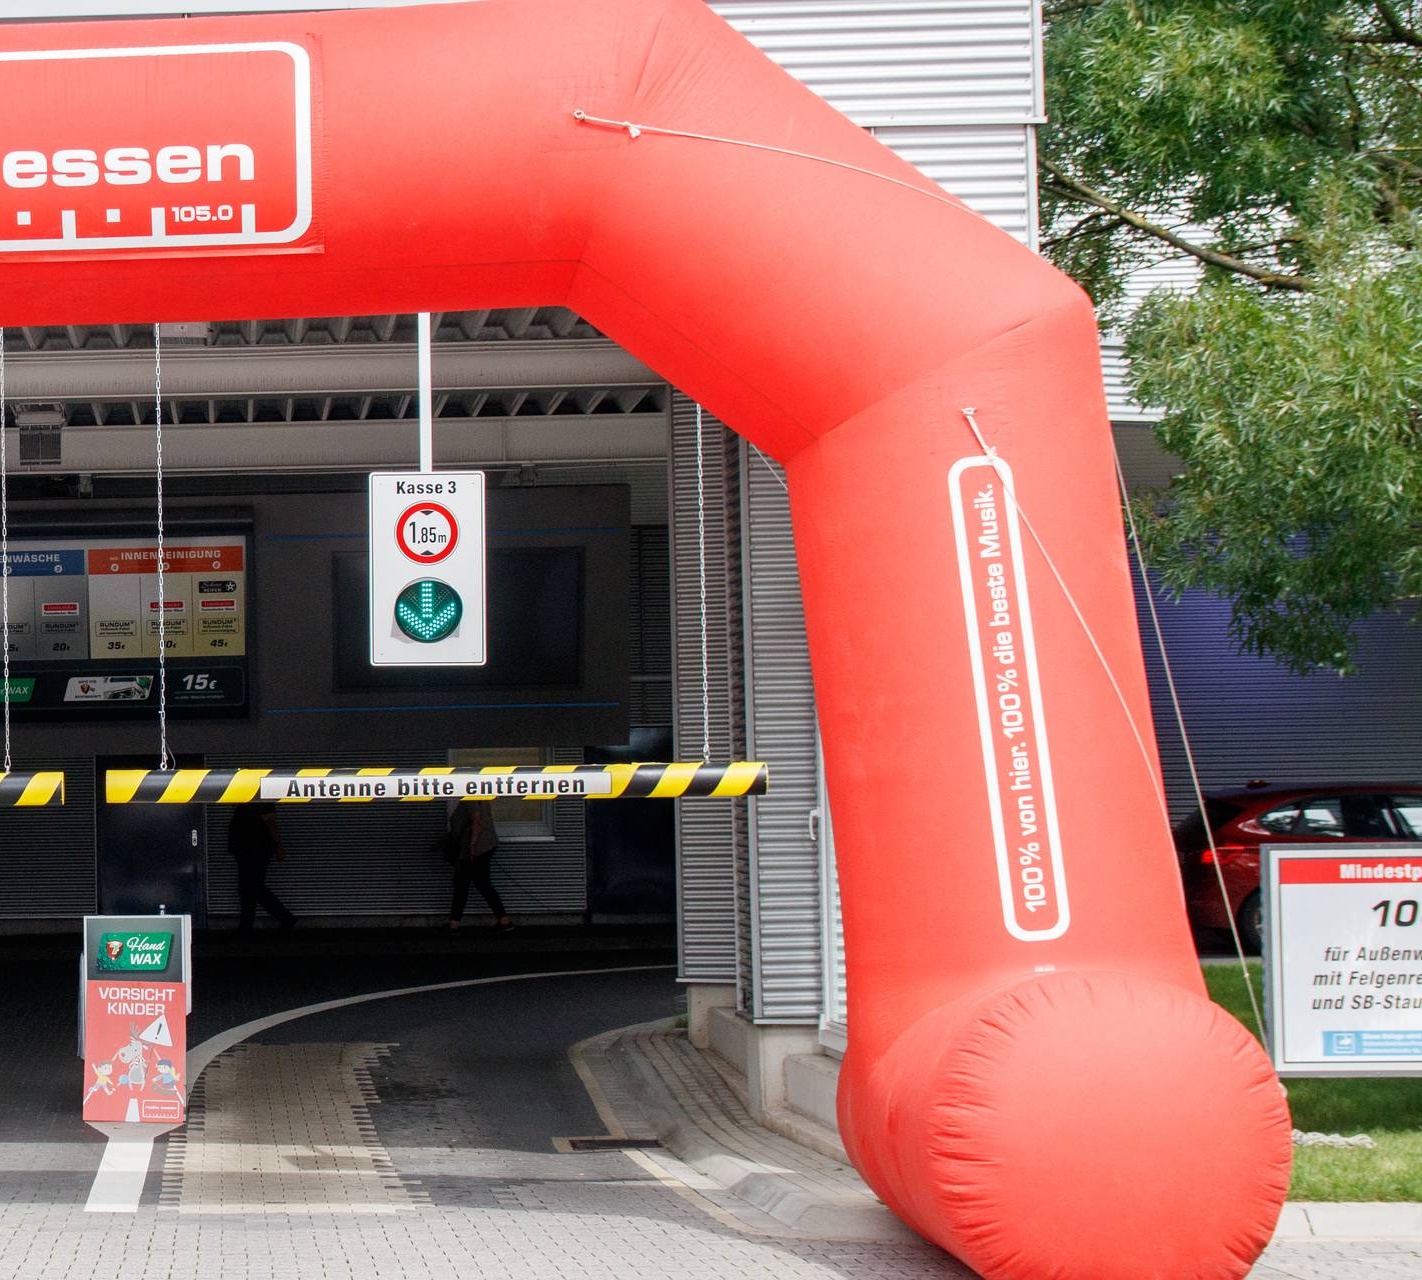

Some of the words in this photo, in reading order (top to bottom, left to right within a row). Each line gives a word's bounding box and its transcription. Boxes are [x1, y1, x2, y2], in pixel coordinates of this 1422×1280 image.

[3, 143, 255, 187] essen
[171, 205, 233, 223] 105.0
[396, 481, 443, 494] Kasse
[448, 481, 457, 494] 3
[974, 483, 1001, 559] Musik.
[987, 563, 1010, 627] beste
[993, 632, 1015, 664] die
[182, 673, 217, 690] 15€
[1009, 742, 1032, 790] hier.
[287, 779, 386, 797] Antenne
[397, 778, 454, 796] bitte
[465, 778, 585, 796] entfernen
[1018, 796, 1037, 836] von
[126, 936, 166, 951] Hand
[130, 953, 163, 965] WAX
[1324, 947, 1349, 961] für
[1313, 972, 1342, 986] mit
[98, 987, 176, 1001] VORSICHT
[1312, 995, 1345, 1010] und
[107, 1001, 166, 1016] KINDER
